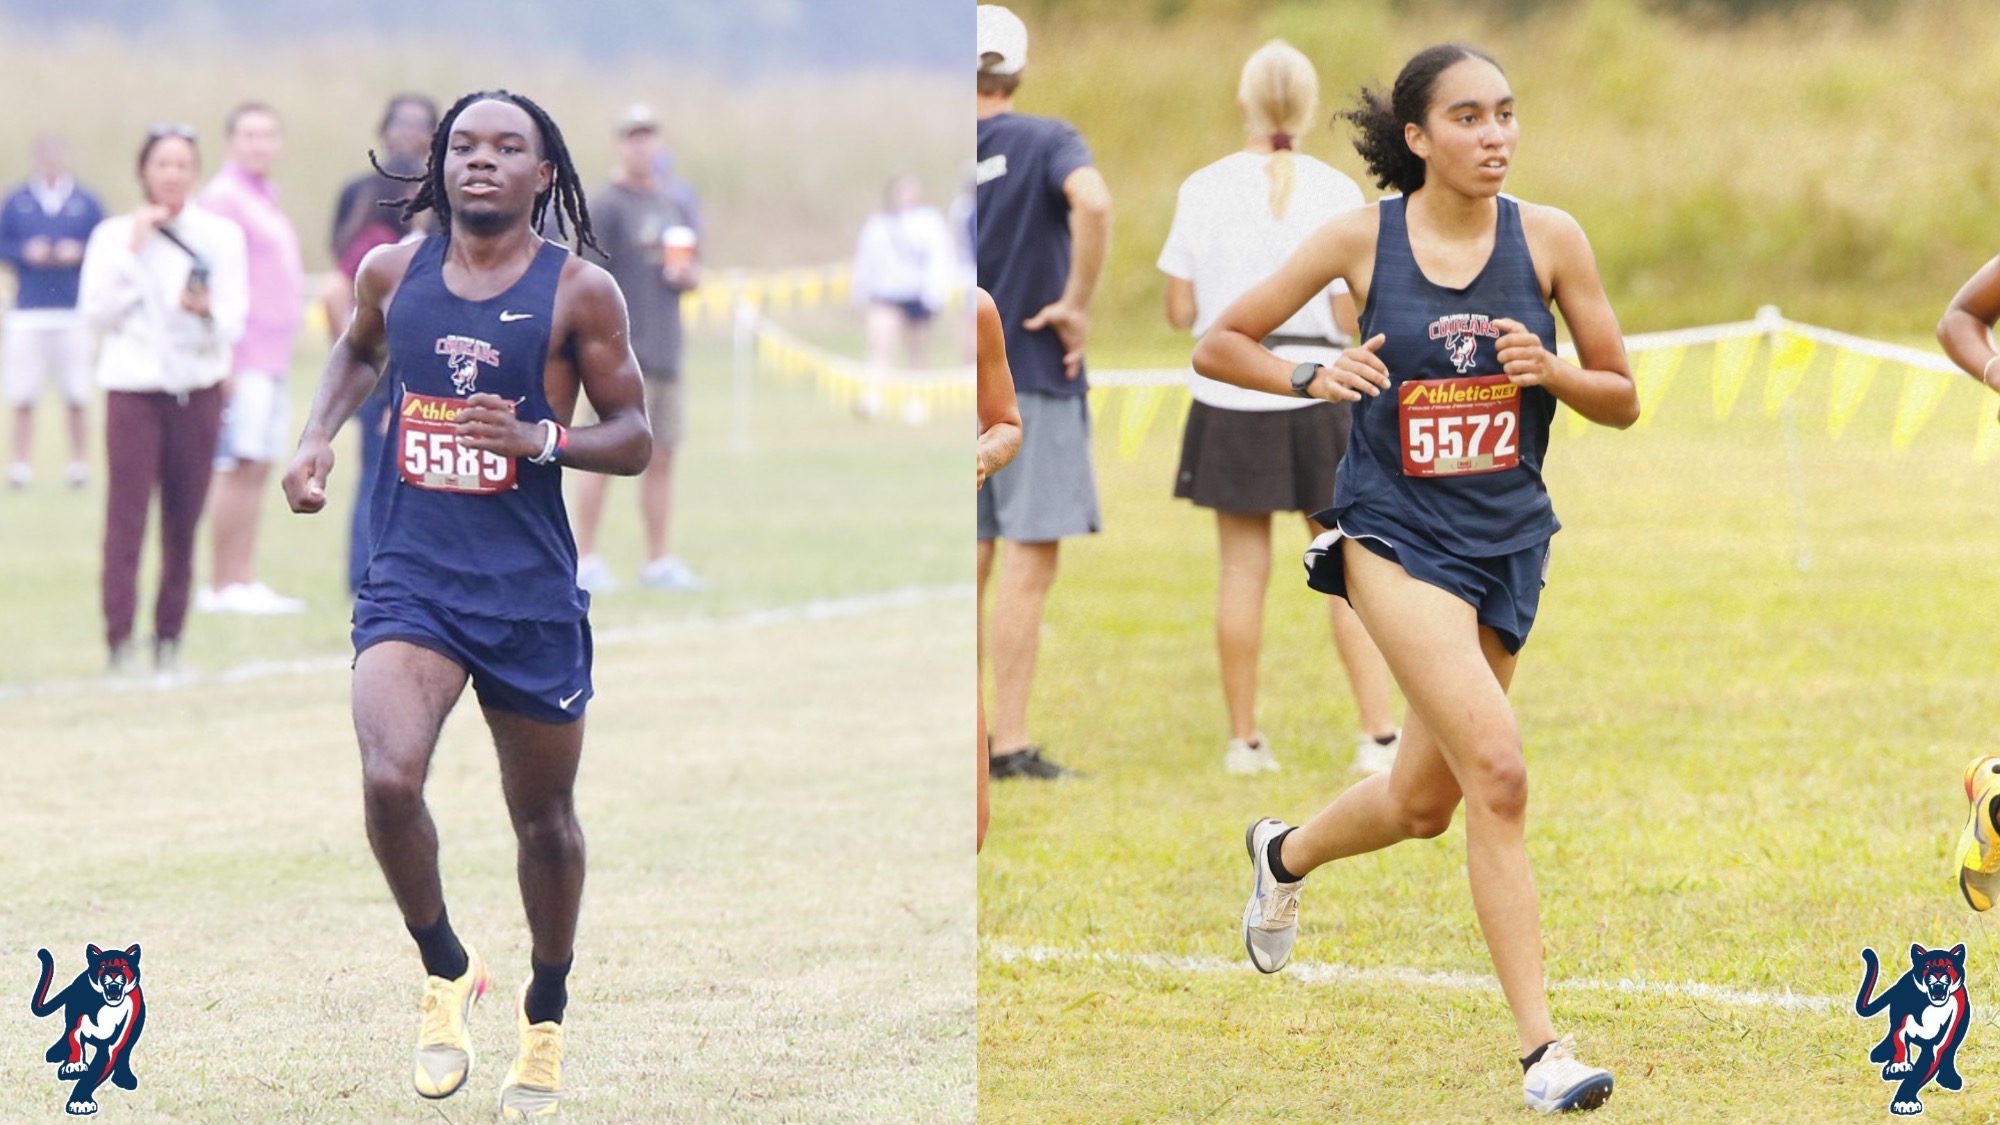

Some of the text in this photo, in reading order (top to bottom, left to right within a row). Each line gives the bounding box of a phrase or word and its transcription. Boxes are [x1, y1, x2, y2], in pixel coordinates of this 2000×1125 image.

[1429, 319, 1500, 340] COUGARS
[1402, 383, 1516, 405] Athletic NET
[404, 429, 508, 482] 5585
[1408, 411, 1516, 464] 5572
